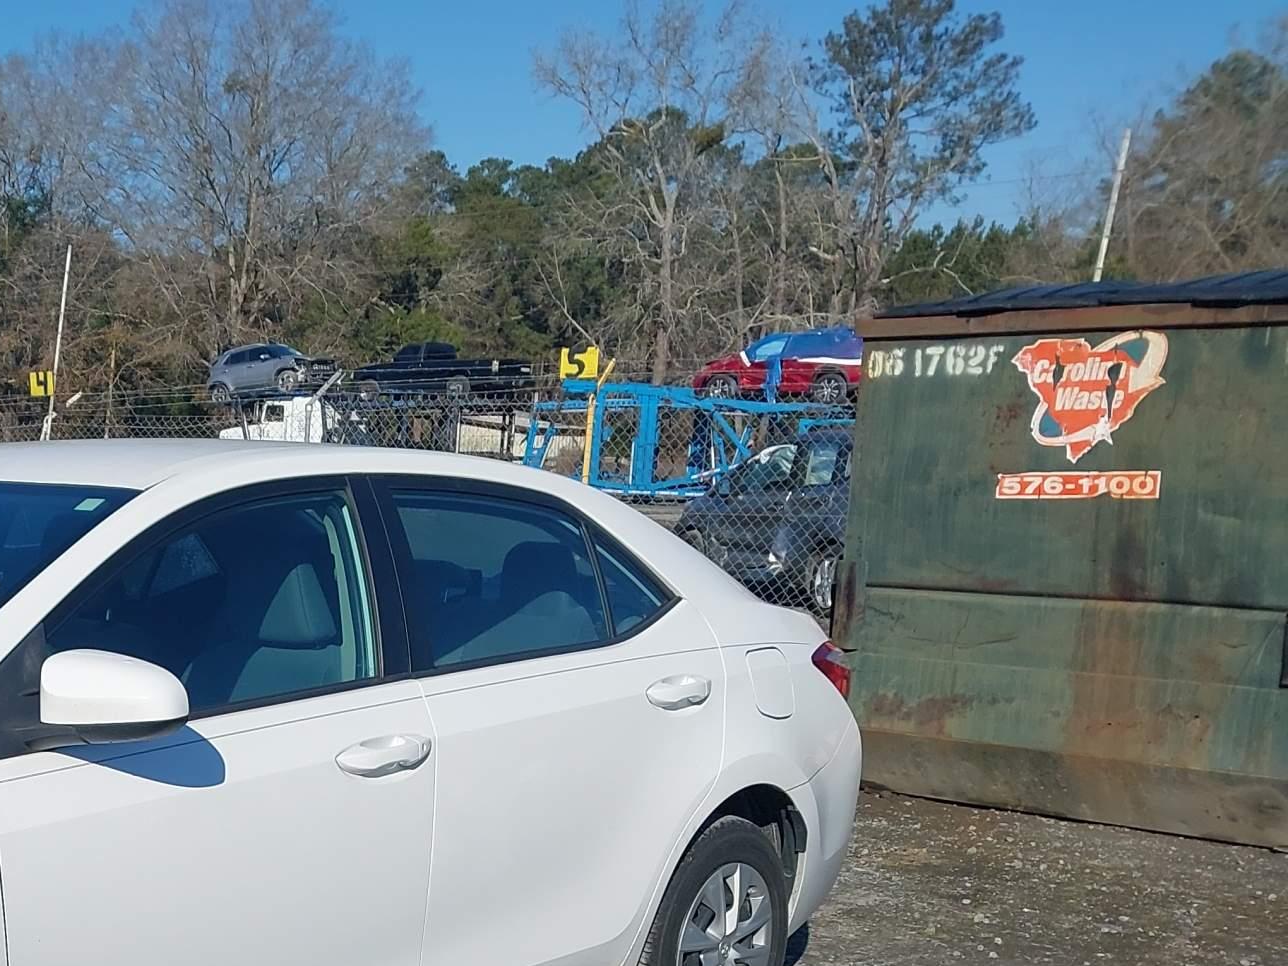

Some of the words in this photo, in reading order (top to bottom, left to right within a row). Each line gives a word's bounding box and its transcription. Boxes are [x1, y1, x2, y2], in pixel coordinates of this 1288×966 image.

[565, 346, 588, 378] 5
[36, 371, 48, 395] 4
[1055, 386, 1125, 411] Waste
[1001, 476, 1154, 495] 576-1100
